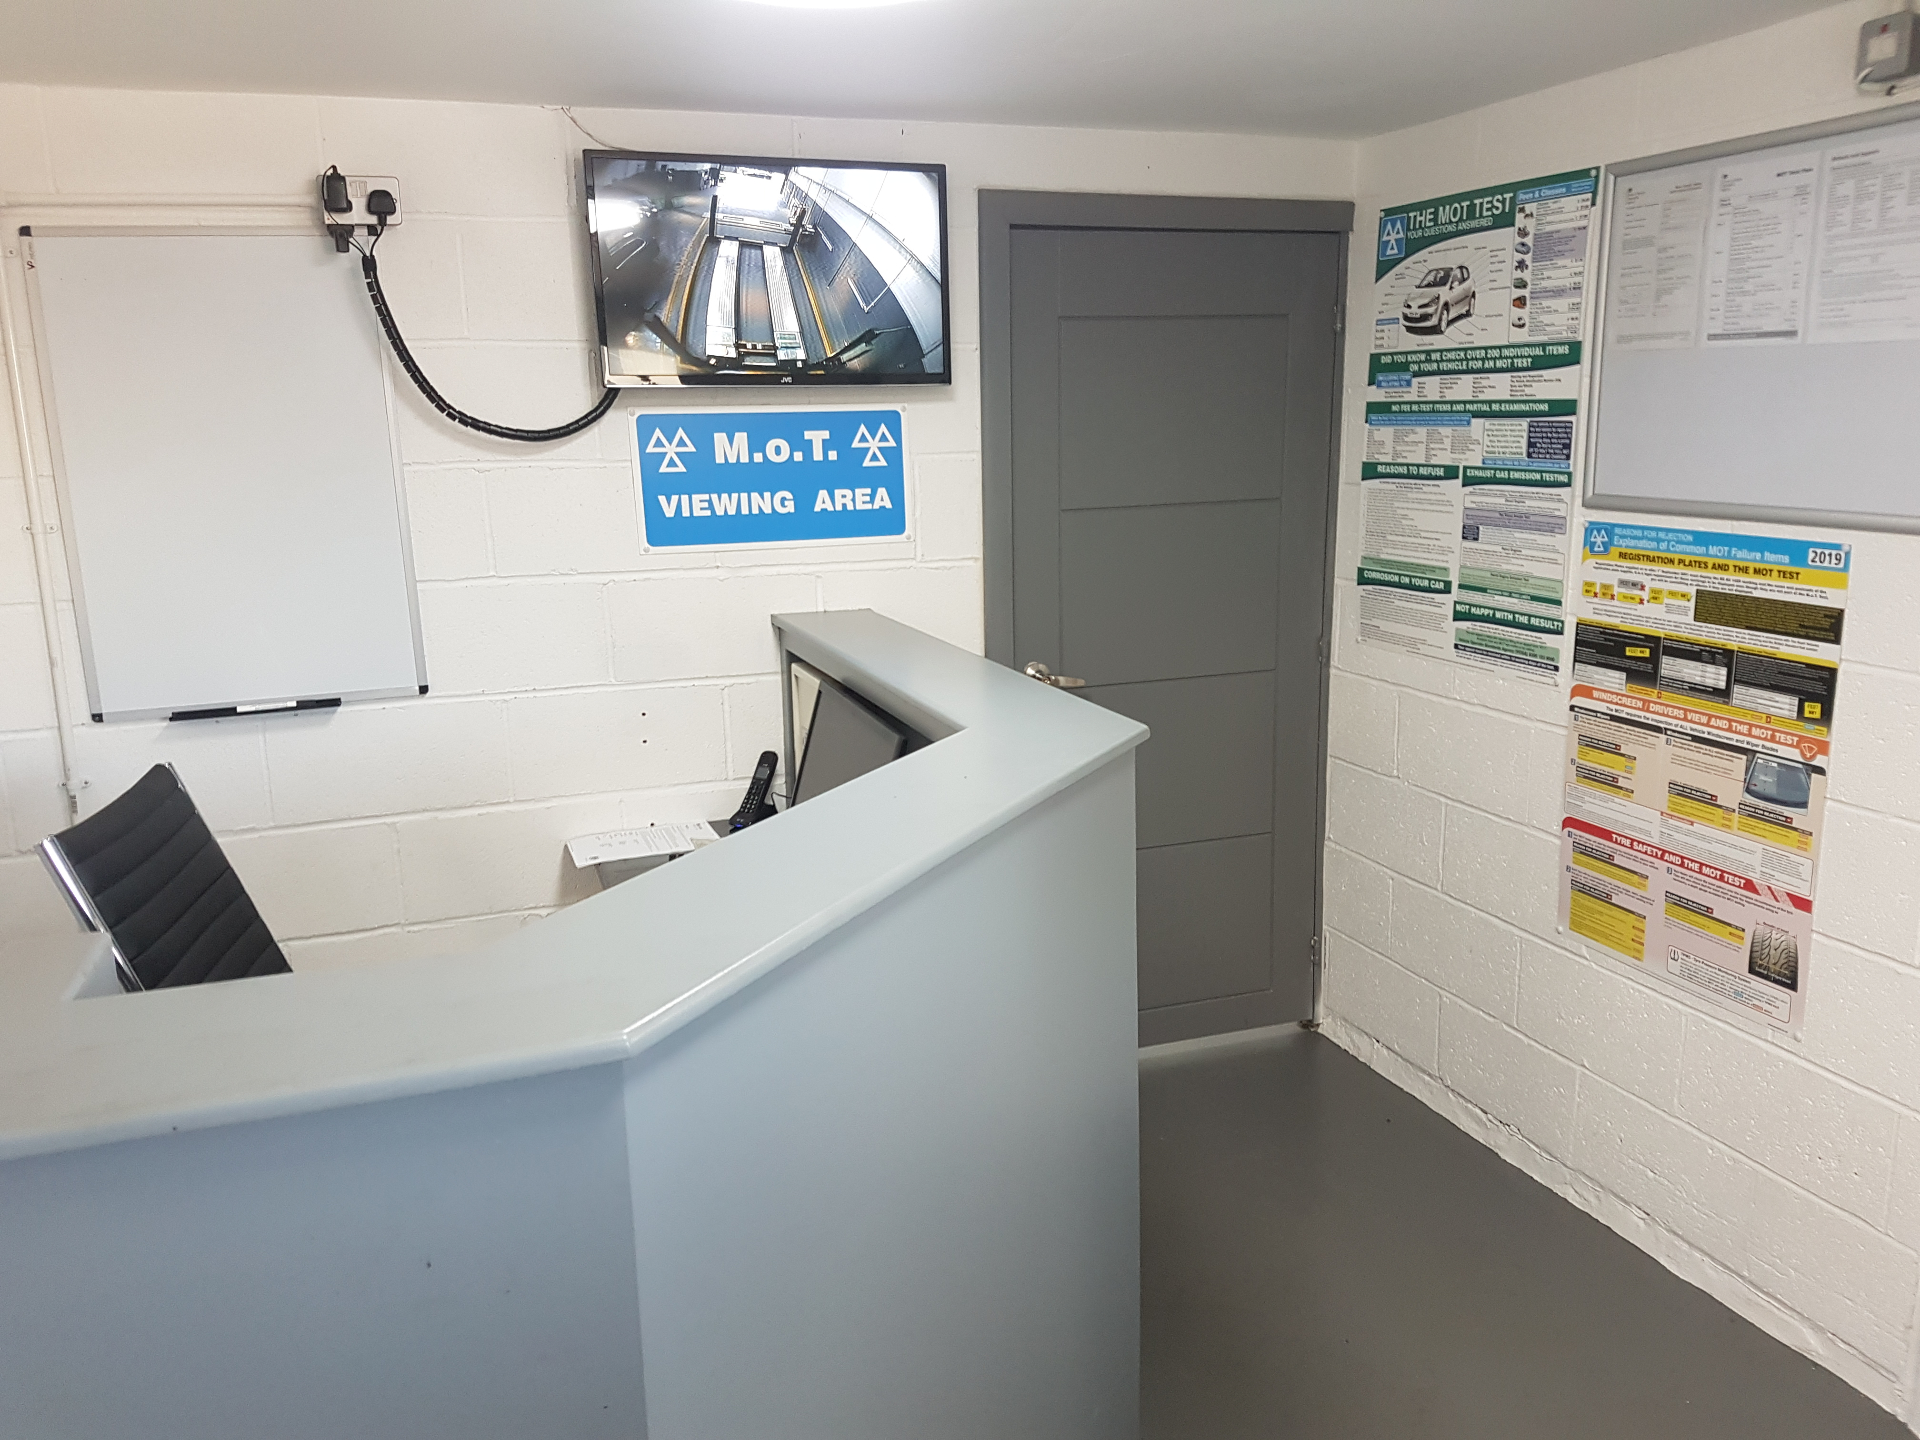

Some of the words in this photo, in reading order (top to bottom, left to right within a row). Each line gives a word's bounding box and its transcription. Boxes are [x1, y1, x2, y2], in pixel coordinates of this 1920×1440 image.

[1409, 208, 1434, 230] THE
[1438, 201, 1470, 225] MOT
[1474, 193, 1514, 218] TEST
[1408, 230, 1423, 240] YOUR
[1424, 223, 1456, 237] QUESTIONS
[1458, 217, 1494, 231] ANSWERED
[1381, 355, 1392, 364] DID
[1394, 354, 1406, 363] YOU
[1408, 353, 1426, 362] KNOW
[1431, 352, 1441, 360] WE
[1442, 350, 1466, 360] CHECK
[1467, 350, 1486, 359] OVER
[1487, 349, 1500, 358] 200
[1501, 347, 1544, 358] INDIVIDUAL
[1546, 345, 1570, 355] ITEMS
[1410, 364, 1418, 372] ON
[1420, 363, 1438, 372] YOUR
[1440, 361, 1467, 370] VEHICLE
[1468, 360, 1482, 370] FOR
[1484, 360, 1494, 368] AN
[1496, 359, 1512, 368] MOT
[1514, 358, 1532, 367] TEST
[1400, 404, 1410, 412] FEE
[1412, 404, 1433, 412] RE-TEST
[1434, 404, 1451, 412] ITEMS
[1452, 404, 1464, 412] AND
[1466, 404, 1490, 412] PARTIAL
[1492, 403, 1548, 412] RE-EXAMINATIONS
[714, 430, 838, 464] M.o.T.
[1377, 465, 1408, 474] REASONS
[1409, 466, 1418, 474] TO
[1419, 466, 1444, 476] REFUSE
[1466, 469, 1496, 478] EXHAUST
[1496, 470, 1508, 478] GAS
[1510, 470, 1540, 480] EMISSION
[1542, 472, 1568, 482] TESTING
[658, 491, 795, 518] VIEWING
[814, 488, 892, 512] AREA
[1614, 528, 1642, 536] REASONS
[1644, 530, 1656, 538] FOR
[1658, 532, 1693, 541] REJECTION
[1614, 536, 1658, 550] Explanation
[1660, 540, 1668, 550] of
[1669, 542, 1706, 554] Common
[1709, 545, 1729, 556] MOT
[1732, 547, 1761, 560] Failure
[1764, 552, 1790, 563] Items
[1810, 550, 1842, 566] 2019
[1618, 552, 1675, 566] REGISTRATION
[1678, 558, 1708, 570] PLATES
[1711, 562, 1730, 572] AND
[1733, 564, 1750, 574] THE
[1753, 567, 1774, 577] MOT
[1776, 570, 1800, 580] TEST
[1364, 570, 1399, 582] CORROSION
[1400, 576, 1410, 584] ON
[1412, 578, 1428, 587] YOUR
[1430, 580, 1444, 590] CAR
[1456, 604, 1470, 613] NOT
[1470, 606, 1494, 617] HAPPY
[1495, 610, 1513, 620] WITH
[1514, 613, 1528, 624] THE
[1530, 617, 1562, 630] RESULT?
[1592, 690, 1642, 708] WINDSCREEN
[1650, 704, 1684, 718] DRIVERS
[1687, 712, 1708, 724] VIEW
[1710, 718, 1728, 728] AND
[1731, 722, 1750, 734] THE
[1752, 727, 1772, 740] MOT
[1775, 732, 1800, 746] TEST
[1690, 726, 1706, 734] Vehicle
[1707, 731, 1735, 741] Windscreen
[1746, 740, 1760, 748] Wiper
[1612, 834, 1631, 848] TYRE
[1633, 842, 1662, 858] SAFETY
[1664, 854, 1681, 865] AND
[1684, 859, 1700, 872] THE
[1702, 866, 1722, 879] MOT
[1724, 874, 1746, 888] TEST
